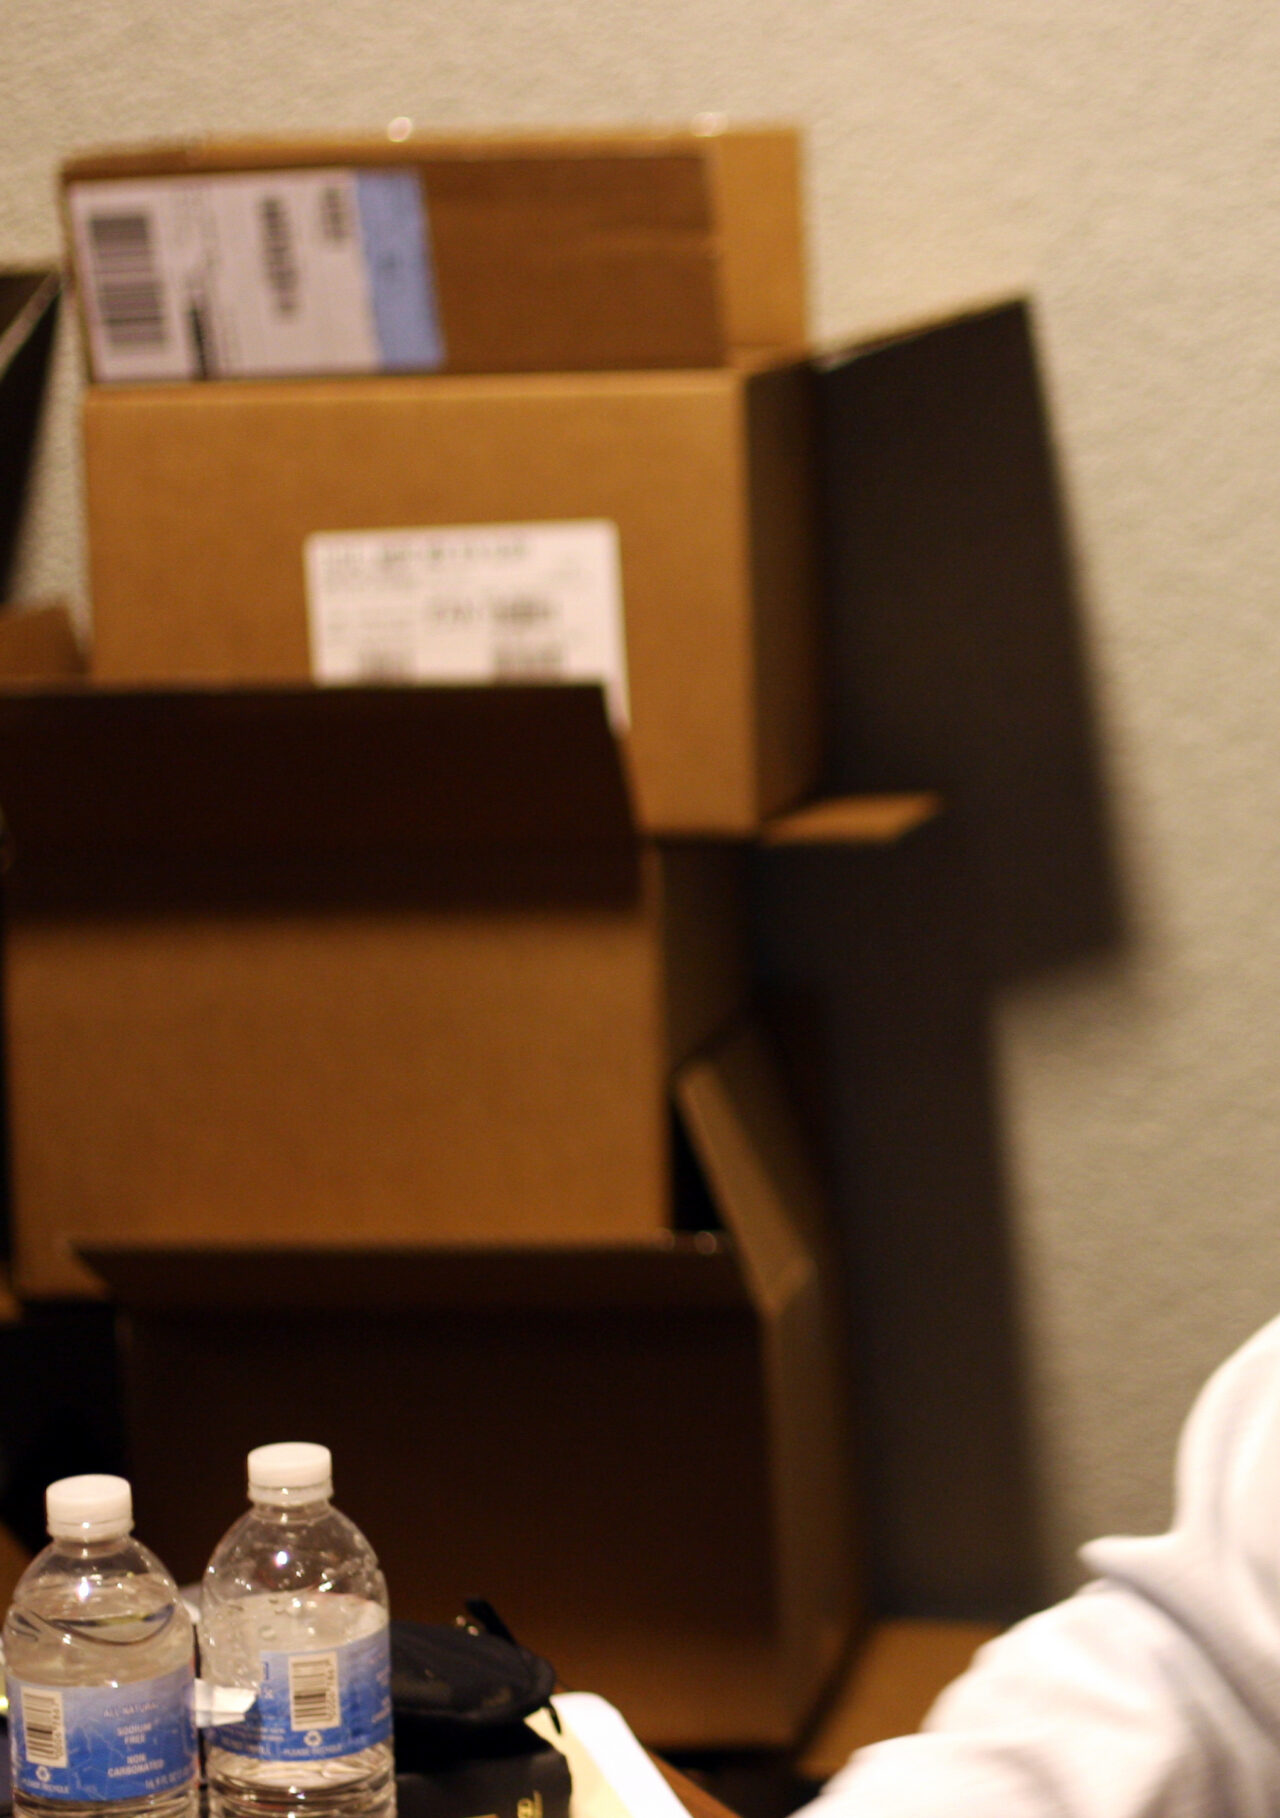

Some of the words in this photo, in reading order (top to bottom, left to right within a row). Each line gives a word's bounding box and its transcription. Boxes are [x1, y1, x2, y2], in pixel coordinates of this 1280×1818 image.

[116, 1722, 152, 1736] SODIUM
[124, 1734, 146, 1745] FREE
[126, 1753, 147, 1765] NON
[107, 1759, 165, 1778] CARBONATED
